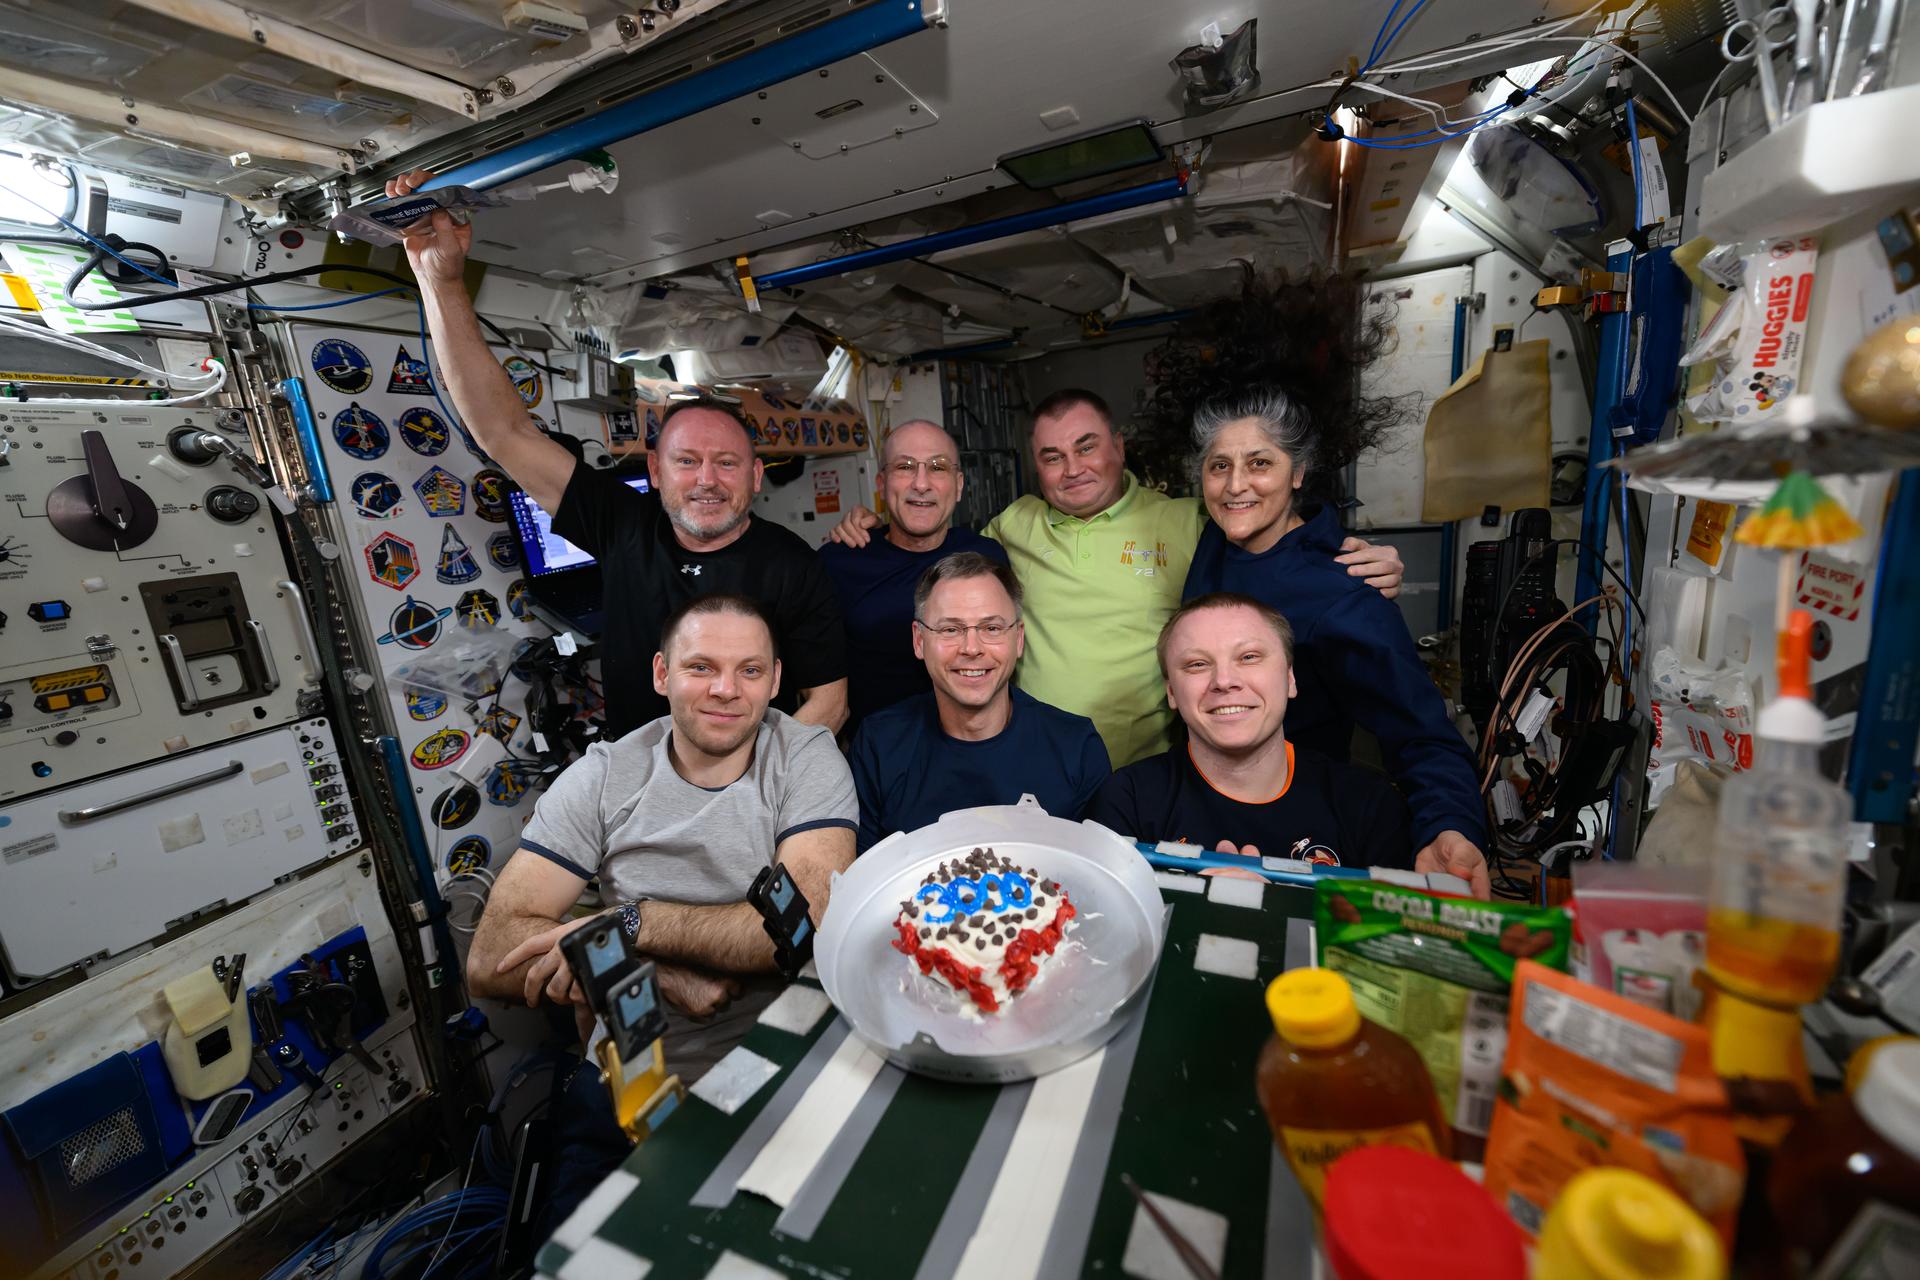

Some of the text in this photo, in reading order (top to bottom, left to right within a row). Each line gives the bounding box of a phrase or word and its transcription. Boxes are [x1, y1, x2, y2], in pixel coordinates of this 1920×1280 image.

[385, 211, 404, 220] RINSE
[404, 207, 421, 218] BODY
[421, 204, 439, 214] BATH
[1752, 275, 1794, 368] HUGGIES
[1782, 331, 1796, 360] simply
[1135, 567, 1154, 577] 72
[1808, 563, 1856, 587] FIRE PORT
[26, 717, 87, 734] FLUSH CONTROLS
[916, 871, 1033, 923] 3000
[1372, 890, 1505, 936] COCOA ROAST
